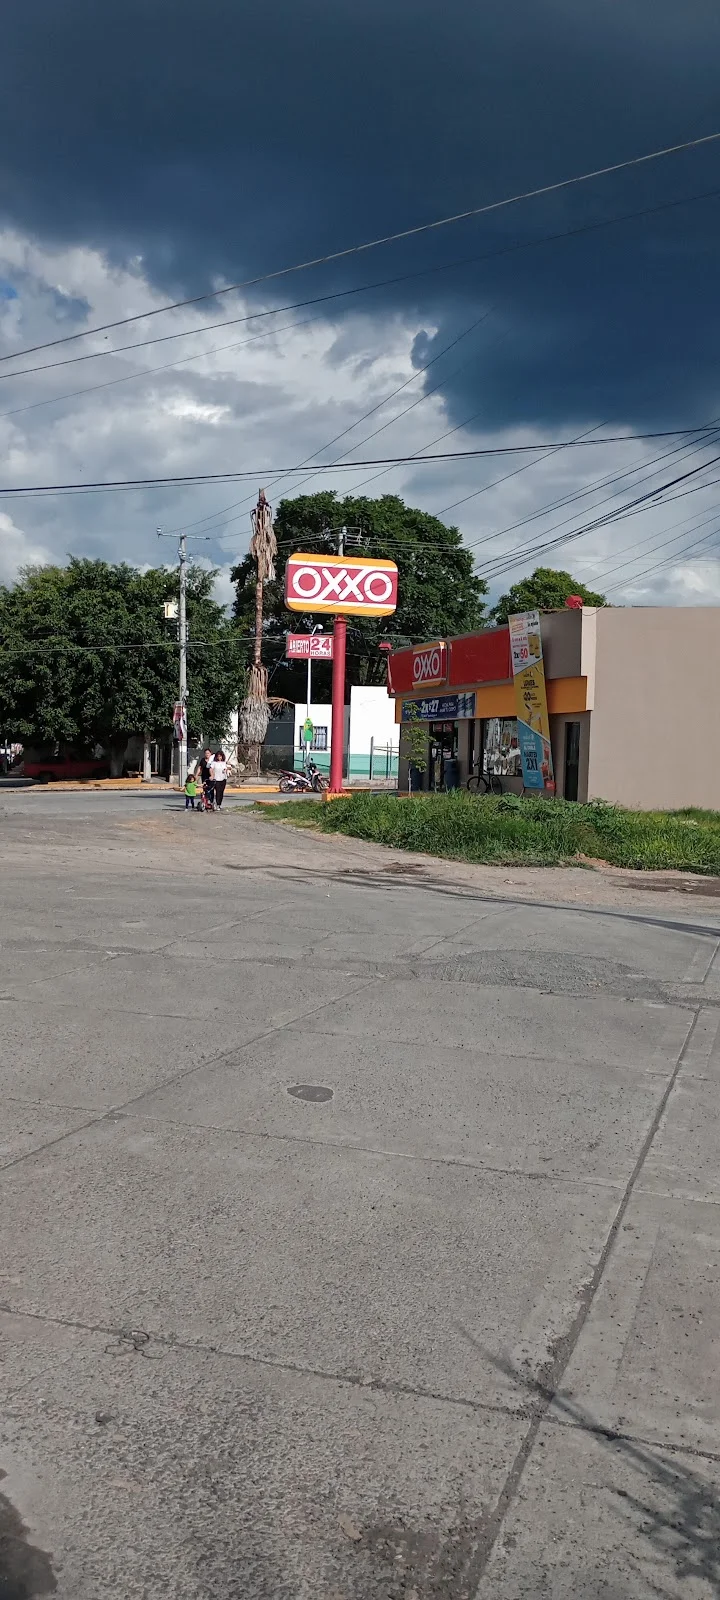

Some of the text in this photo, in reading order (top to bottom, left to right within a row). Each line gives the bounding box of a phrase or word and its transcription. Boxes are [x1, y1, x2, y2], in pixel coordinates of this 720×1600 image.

[292, 567, 393, 602] OXXO
[288, 638, 331, 654] ABIERTO 24
[413, 652, 440, 680] OXXO
